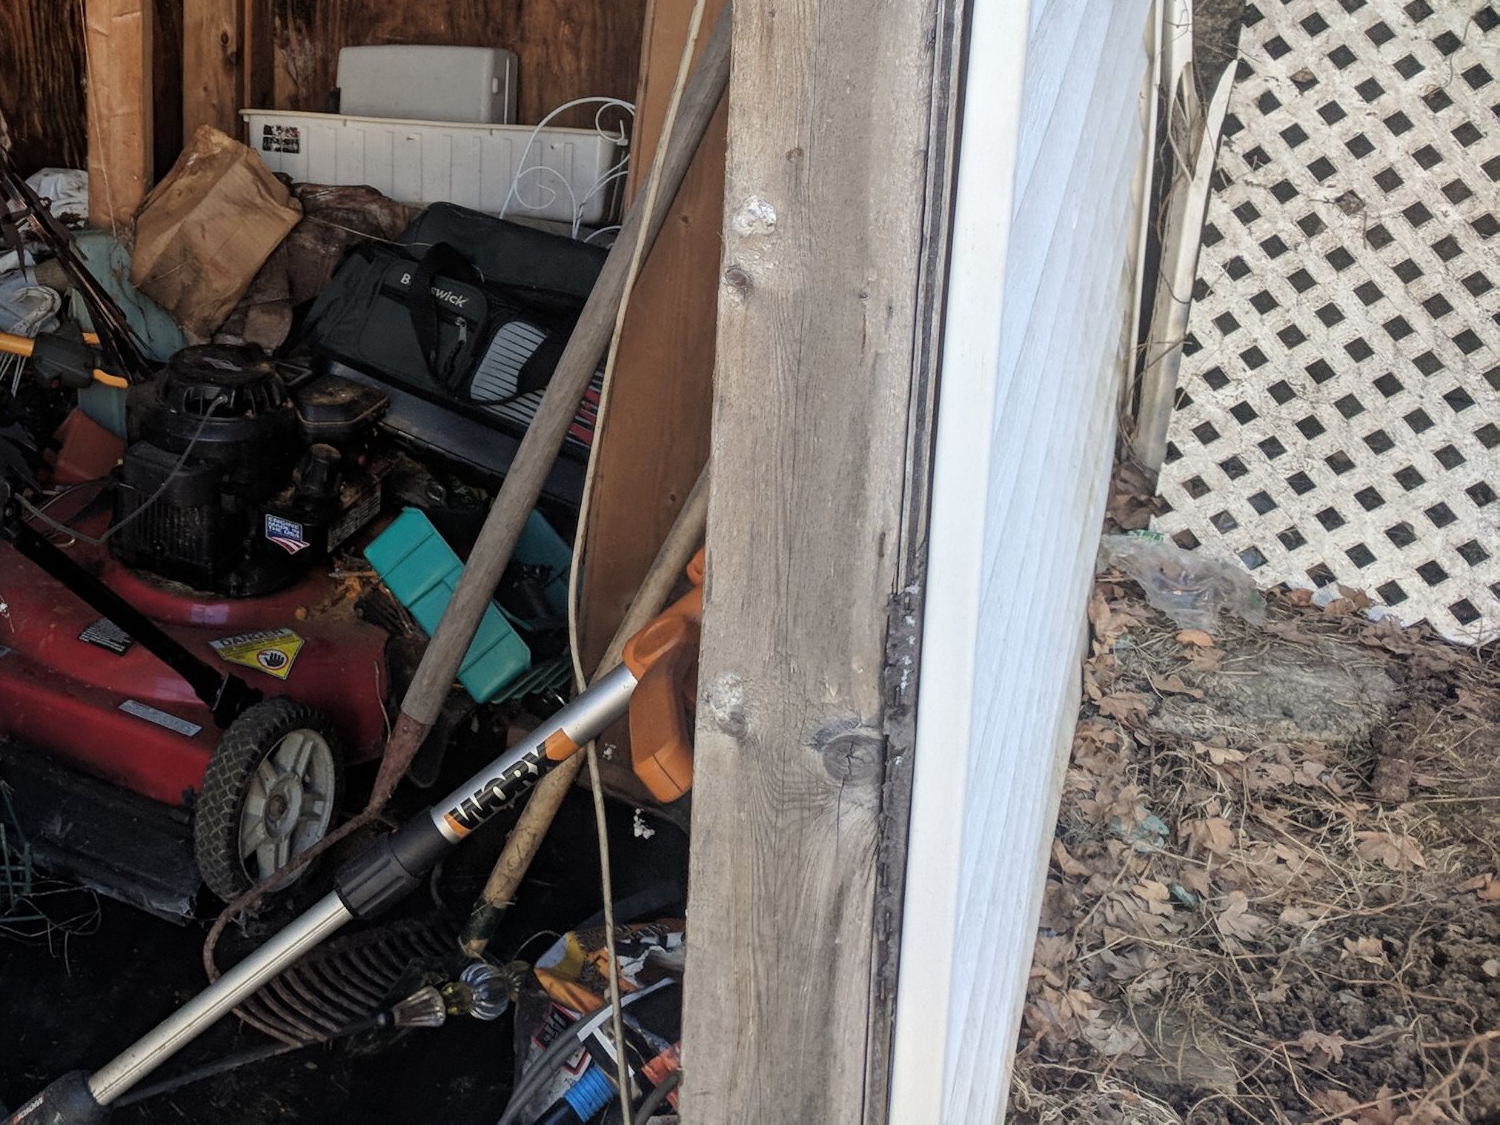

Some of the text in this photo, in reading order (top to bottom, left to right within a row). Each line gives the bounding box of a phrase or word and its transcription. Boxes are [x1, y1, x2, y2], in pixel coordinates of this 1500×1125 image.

[400, 272, 469, 308] Bwick
[220, 628, 285, 646] DANGER
[448, 740, 562, 830] WORX
